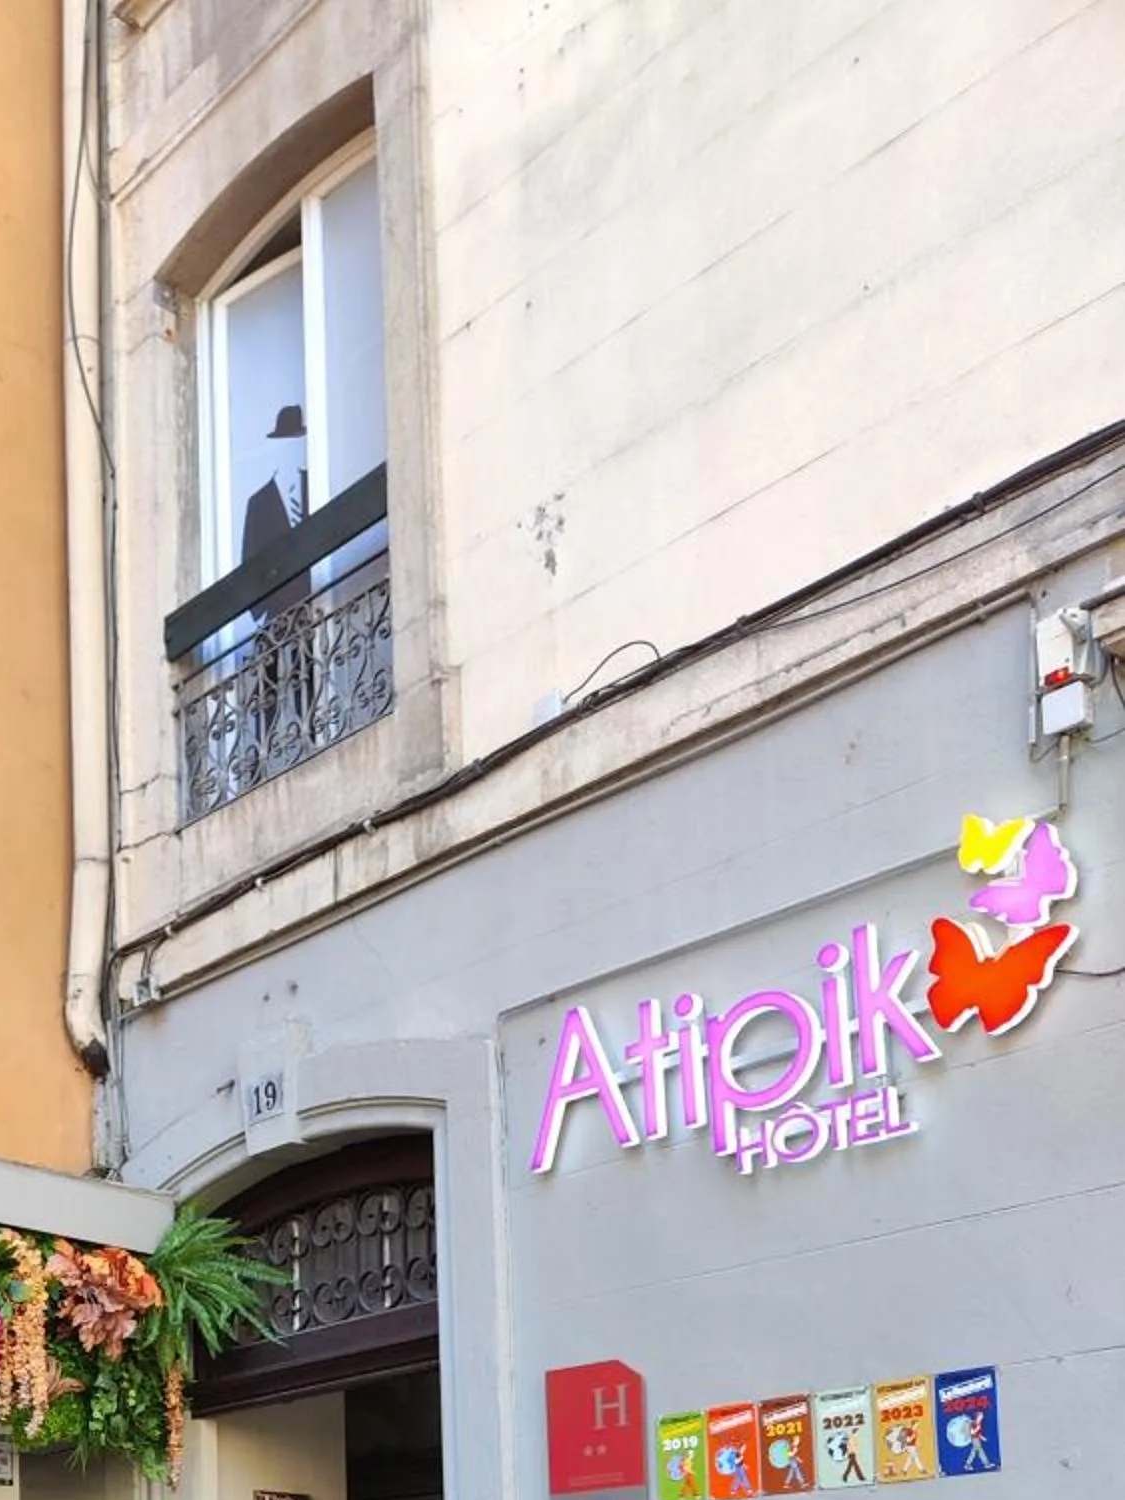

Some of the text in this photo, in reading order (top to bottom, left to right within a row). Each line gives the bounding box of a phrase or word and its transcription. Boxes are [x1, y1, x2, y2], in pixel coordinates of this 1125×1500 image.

[530, 923, 942, 1174] Atipik
[254, 1081, 277, 1115] 19
[736, 1086, 920, 1175] HÔTEL
[592, 1382, 630, 1430] H
[881, 1405, 924, 1422] 2023
[766, 1421, 802, 1437] 2021
[822, 1413, 865, 1430] 2022
[663, 1436, 698, 1450] 2019
